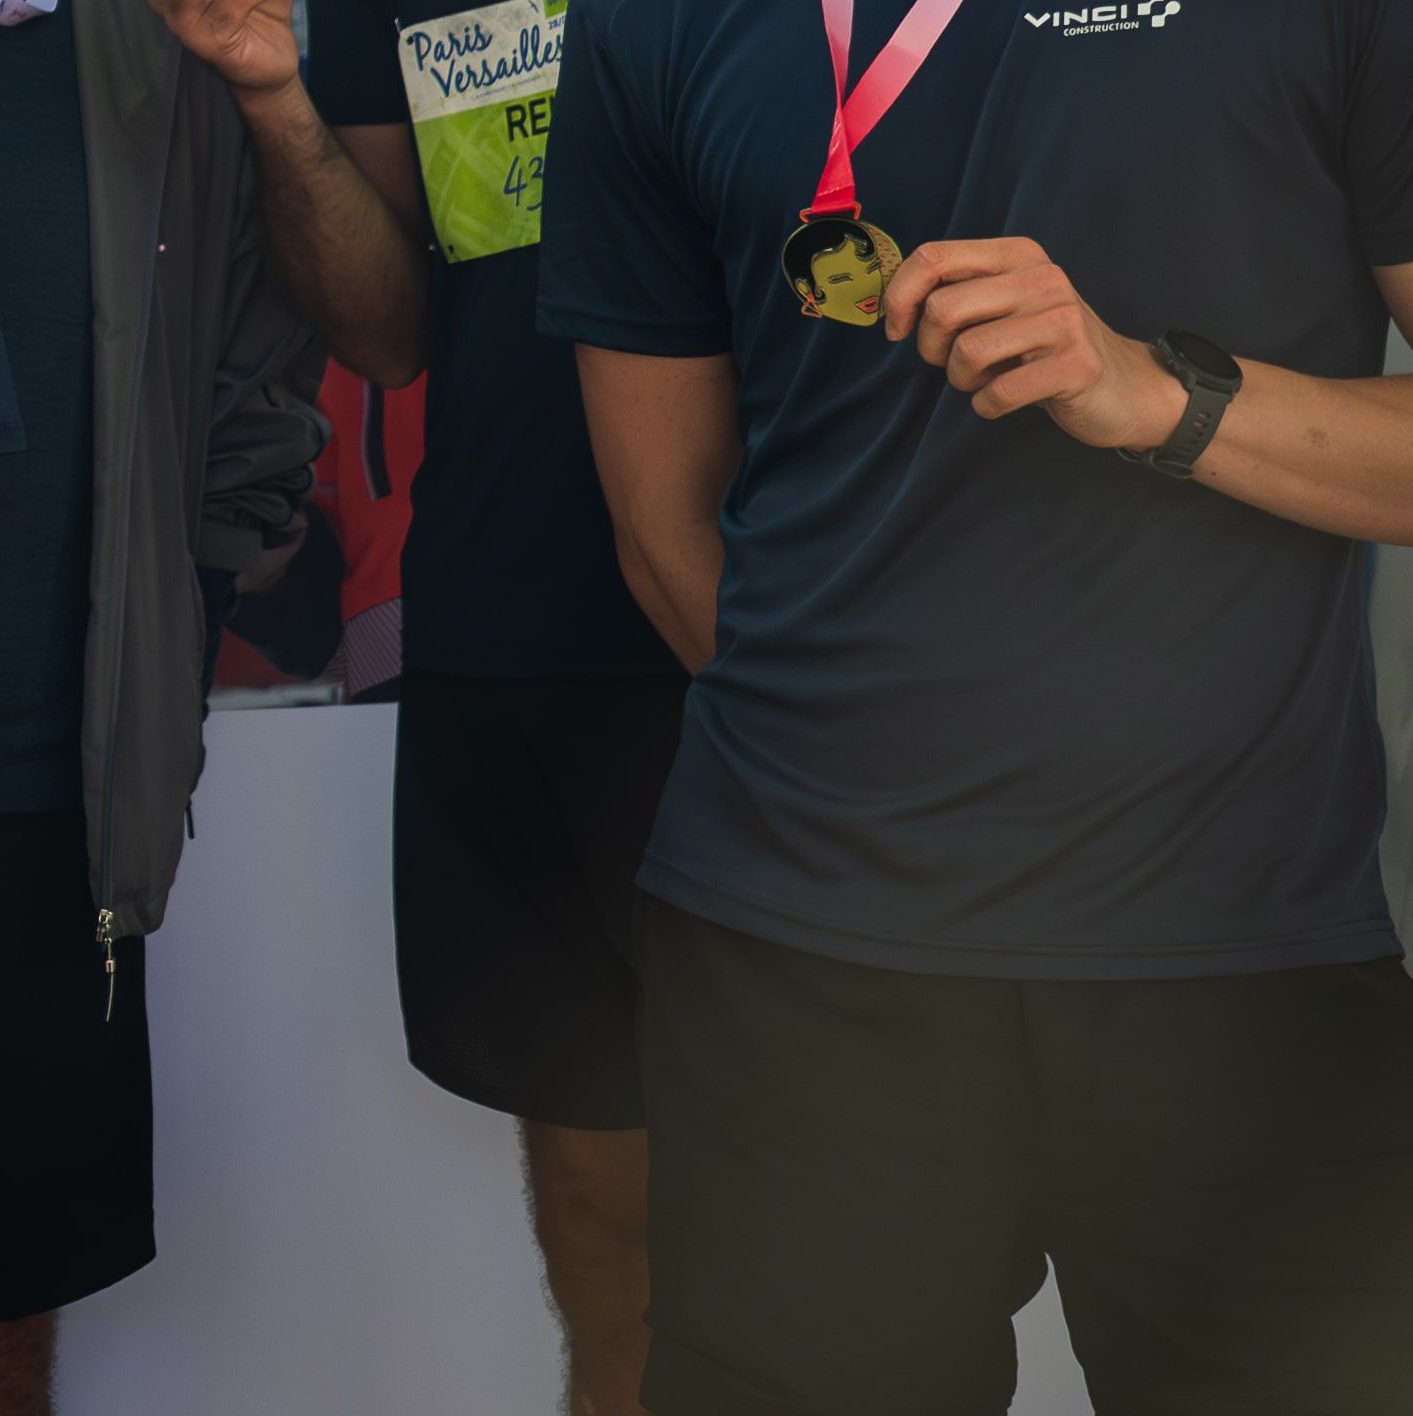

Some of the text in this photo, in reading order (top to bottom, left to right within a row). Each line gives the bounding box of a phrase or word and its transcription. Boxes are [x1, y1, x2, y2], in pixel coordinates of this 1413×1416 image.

[1023, 4, 1128, 28] VINCI
[1063, 21, 1140, 37] CONSTRUCTION
[412, 23, 492, 70] Paris
[505, 95, 555, 142] RE
